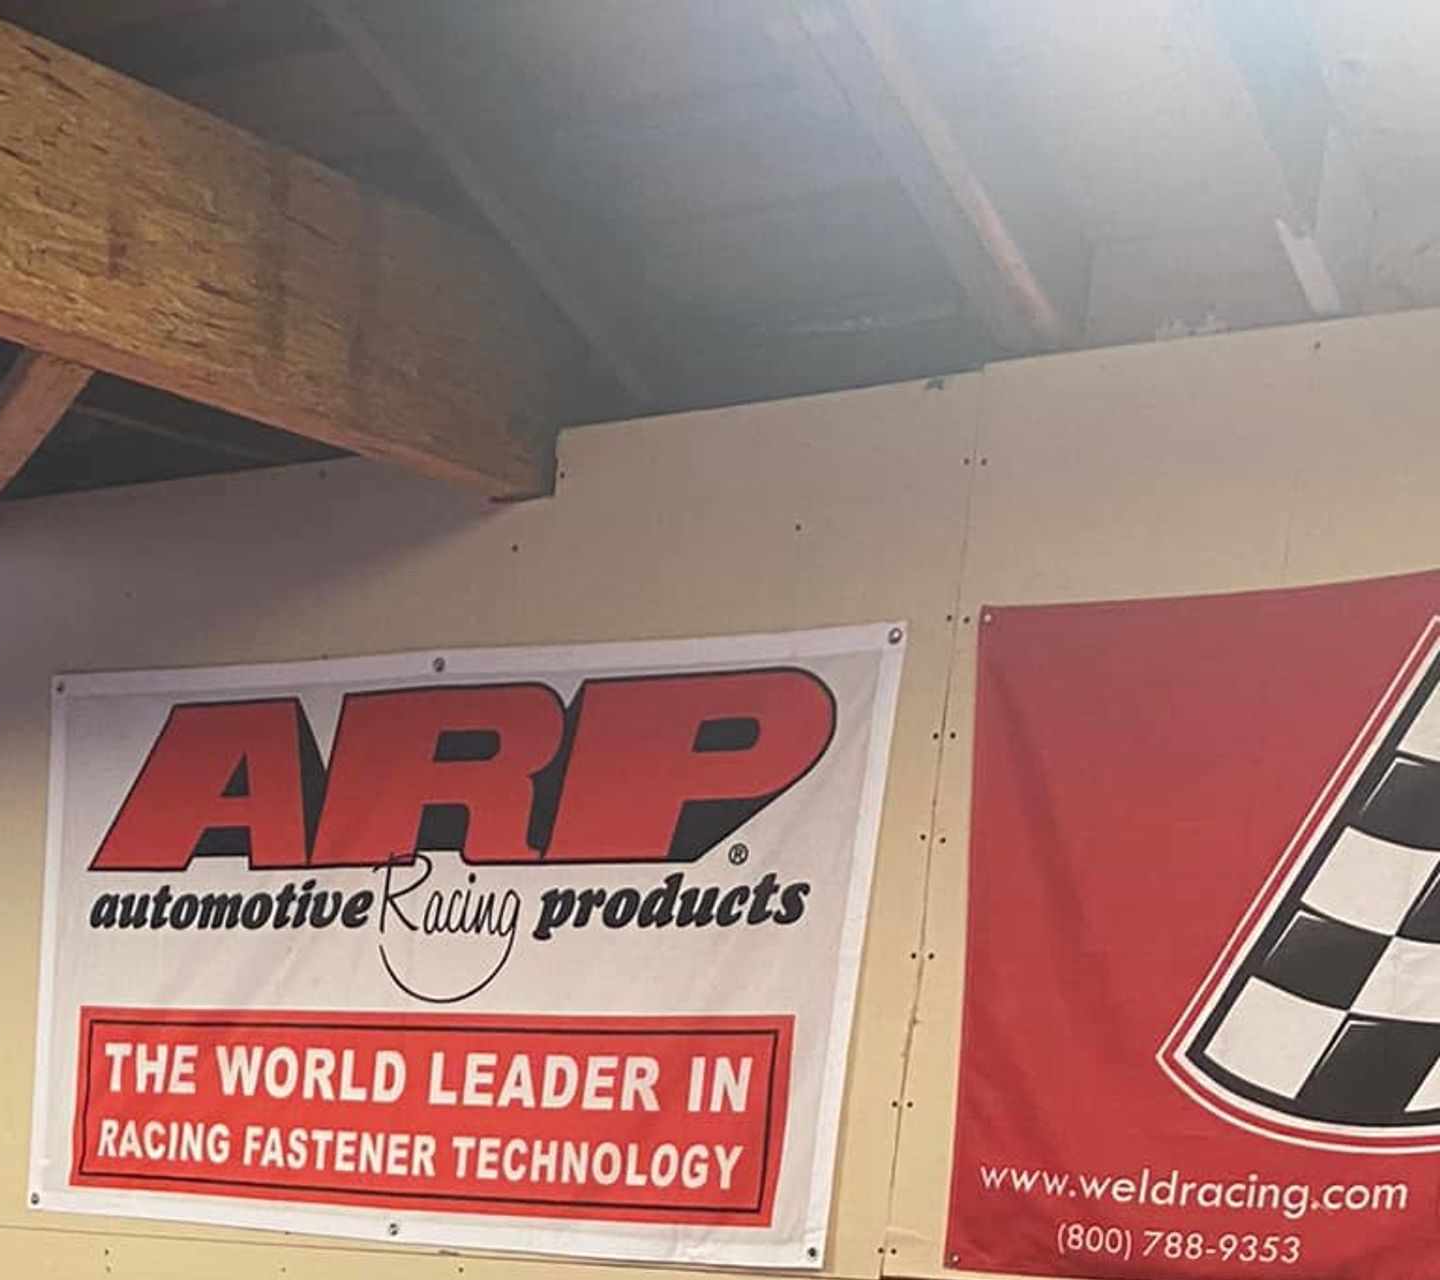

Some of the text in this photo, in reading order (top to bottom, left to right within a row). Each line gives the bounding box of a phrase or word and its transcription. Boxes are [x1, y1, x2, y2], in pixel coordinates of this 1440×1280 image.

[87, 666, 838, 871] ARP
[89, 852, 811, 1003] automotive Racing products
[104, 1042, 754, 1113] THE WORLD LEADER IN
[97, 1118, 744, 1191] RACING FASTENER TECHNOLOGY
[979, 1165, 1410, 1220] www.weldracing.com
[1056, 1222, 1302, 1264] (800) 788-9353
